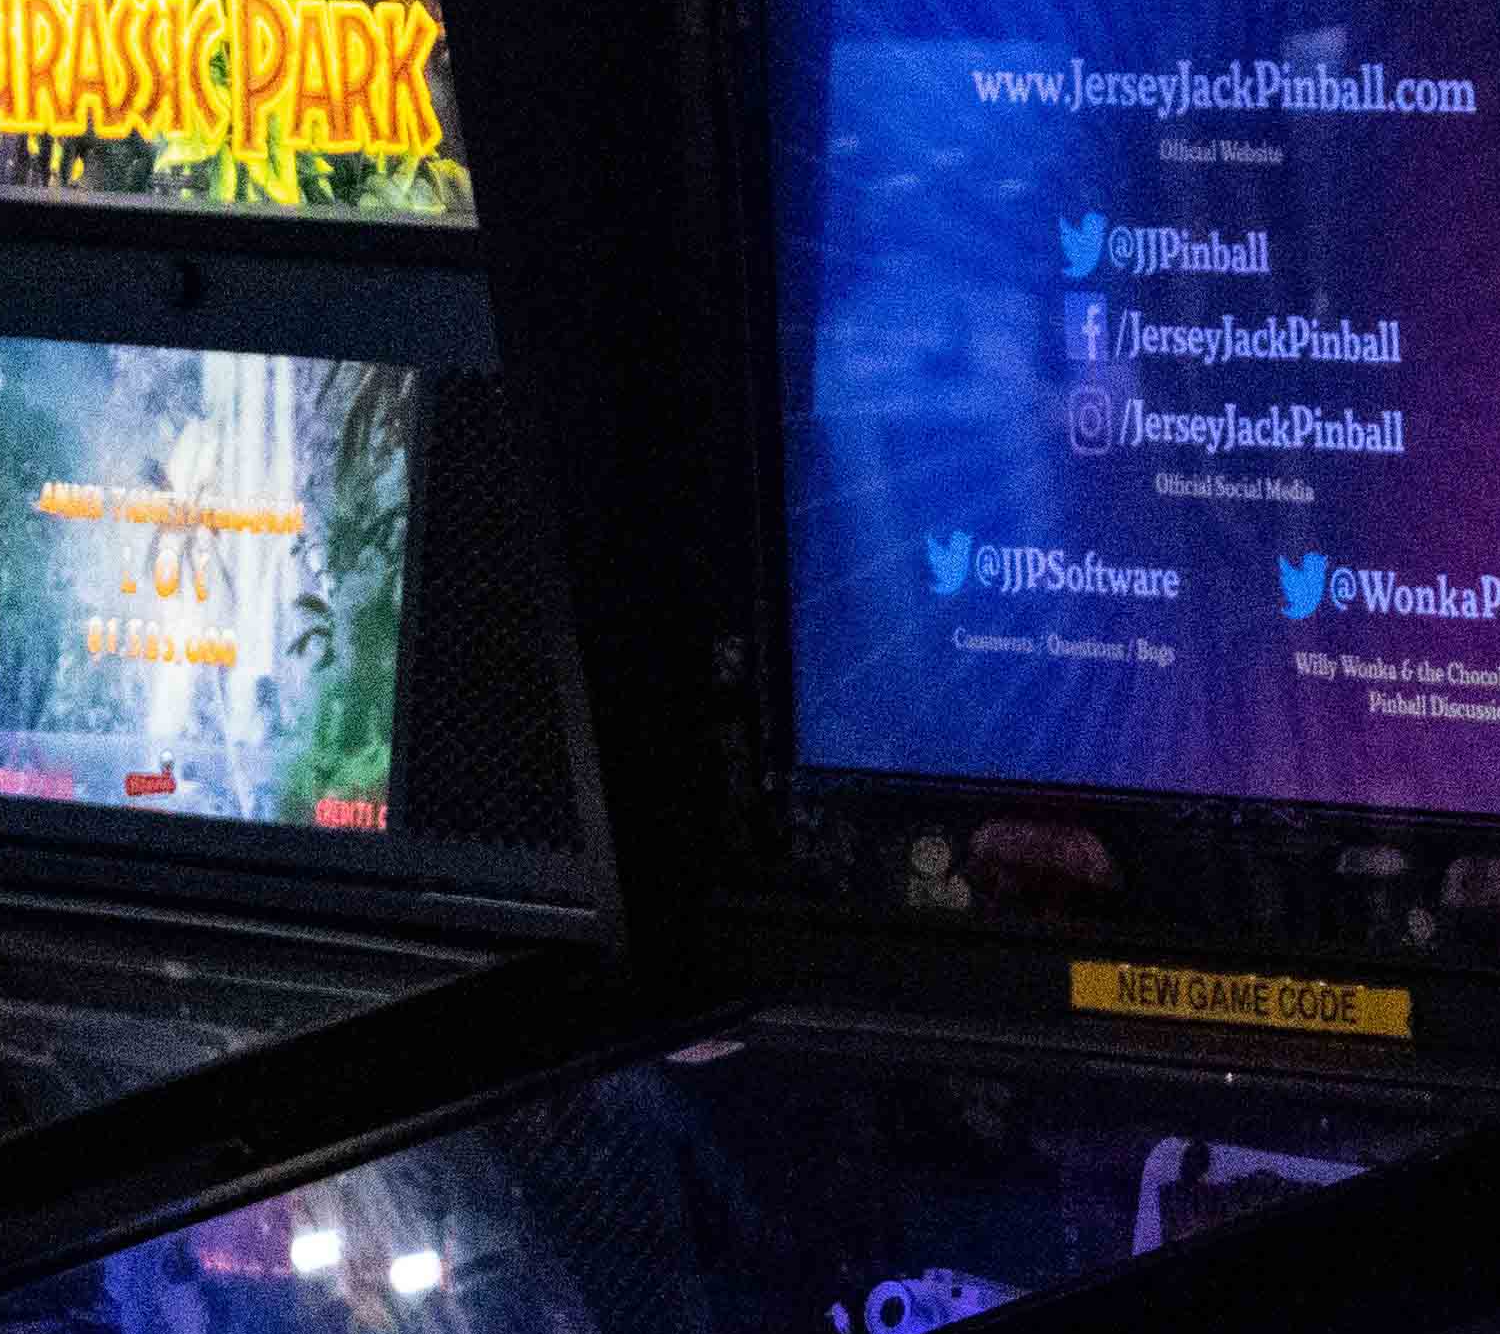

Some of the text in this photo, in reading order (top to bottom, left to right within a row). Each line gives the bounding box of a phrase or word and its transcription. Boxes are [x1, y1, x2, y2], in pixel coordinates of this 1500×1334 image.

[973, 57, 1477, 120] www.JerseyJackPinball.com
[1158, 139, 1284, 166] Official Website
[1108, 226, 1270, 274] @JJPinball
[1114, 308, 1402, 366] /JerseyJackPinball
[1120, 399, 1405, 455] /JerseyJackPinball
[1154, 472, 1213, 499] Official
[975, 540, 1181, 600] @JJPSoftware
[1293, 651, 1338, 681] Willy
[1340, 653, 1398, 682] Wonka
[1416, 659, 1444, 685] the
[1367, 689, 1428, 717] Pinball
[1117, 968, 1359, 1025] NEW GAME CODE
